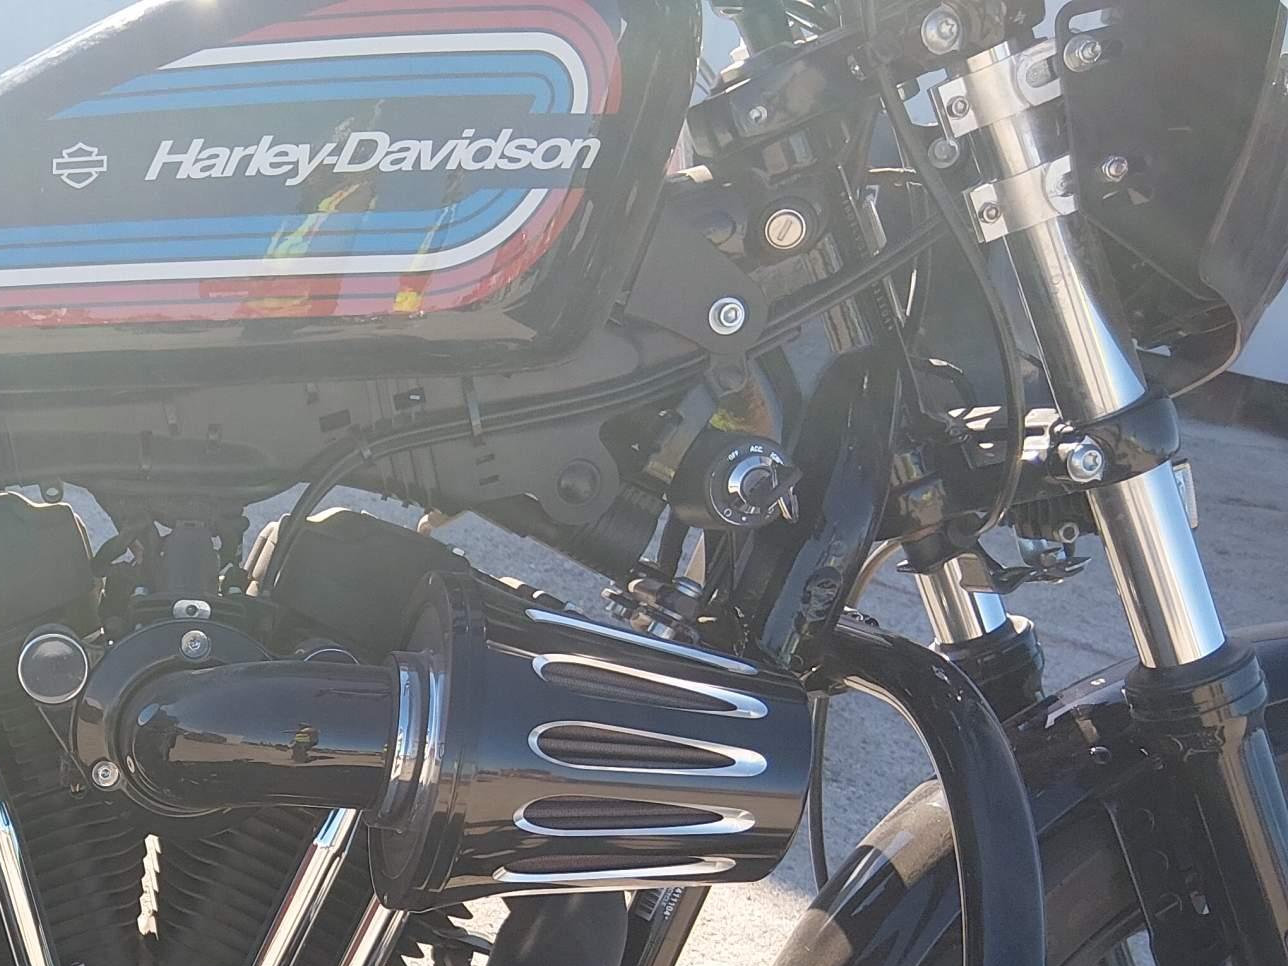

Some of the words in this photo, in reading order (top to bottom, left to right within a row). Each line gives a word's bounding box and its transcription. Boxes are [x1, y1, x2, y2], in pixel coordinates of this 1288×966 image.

[143, 128, 601, 187] Harley-Davidson
[749, 445, 765, 454] ACC
[663, 885, 685, 920] 411104
